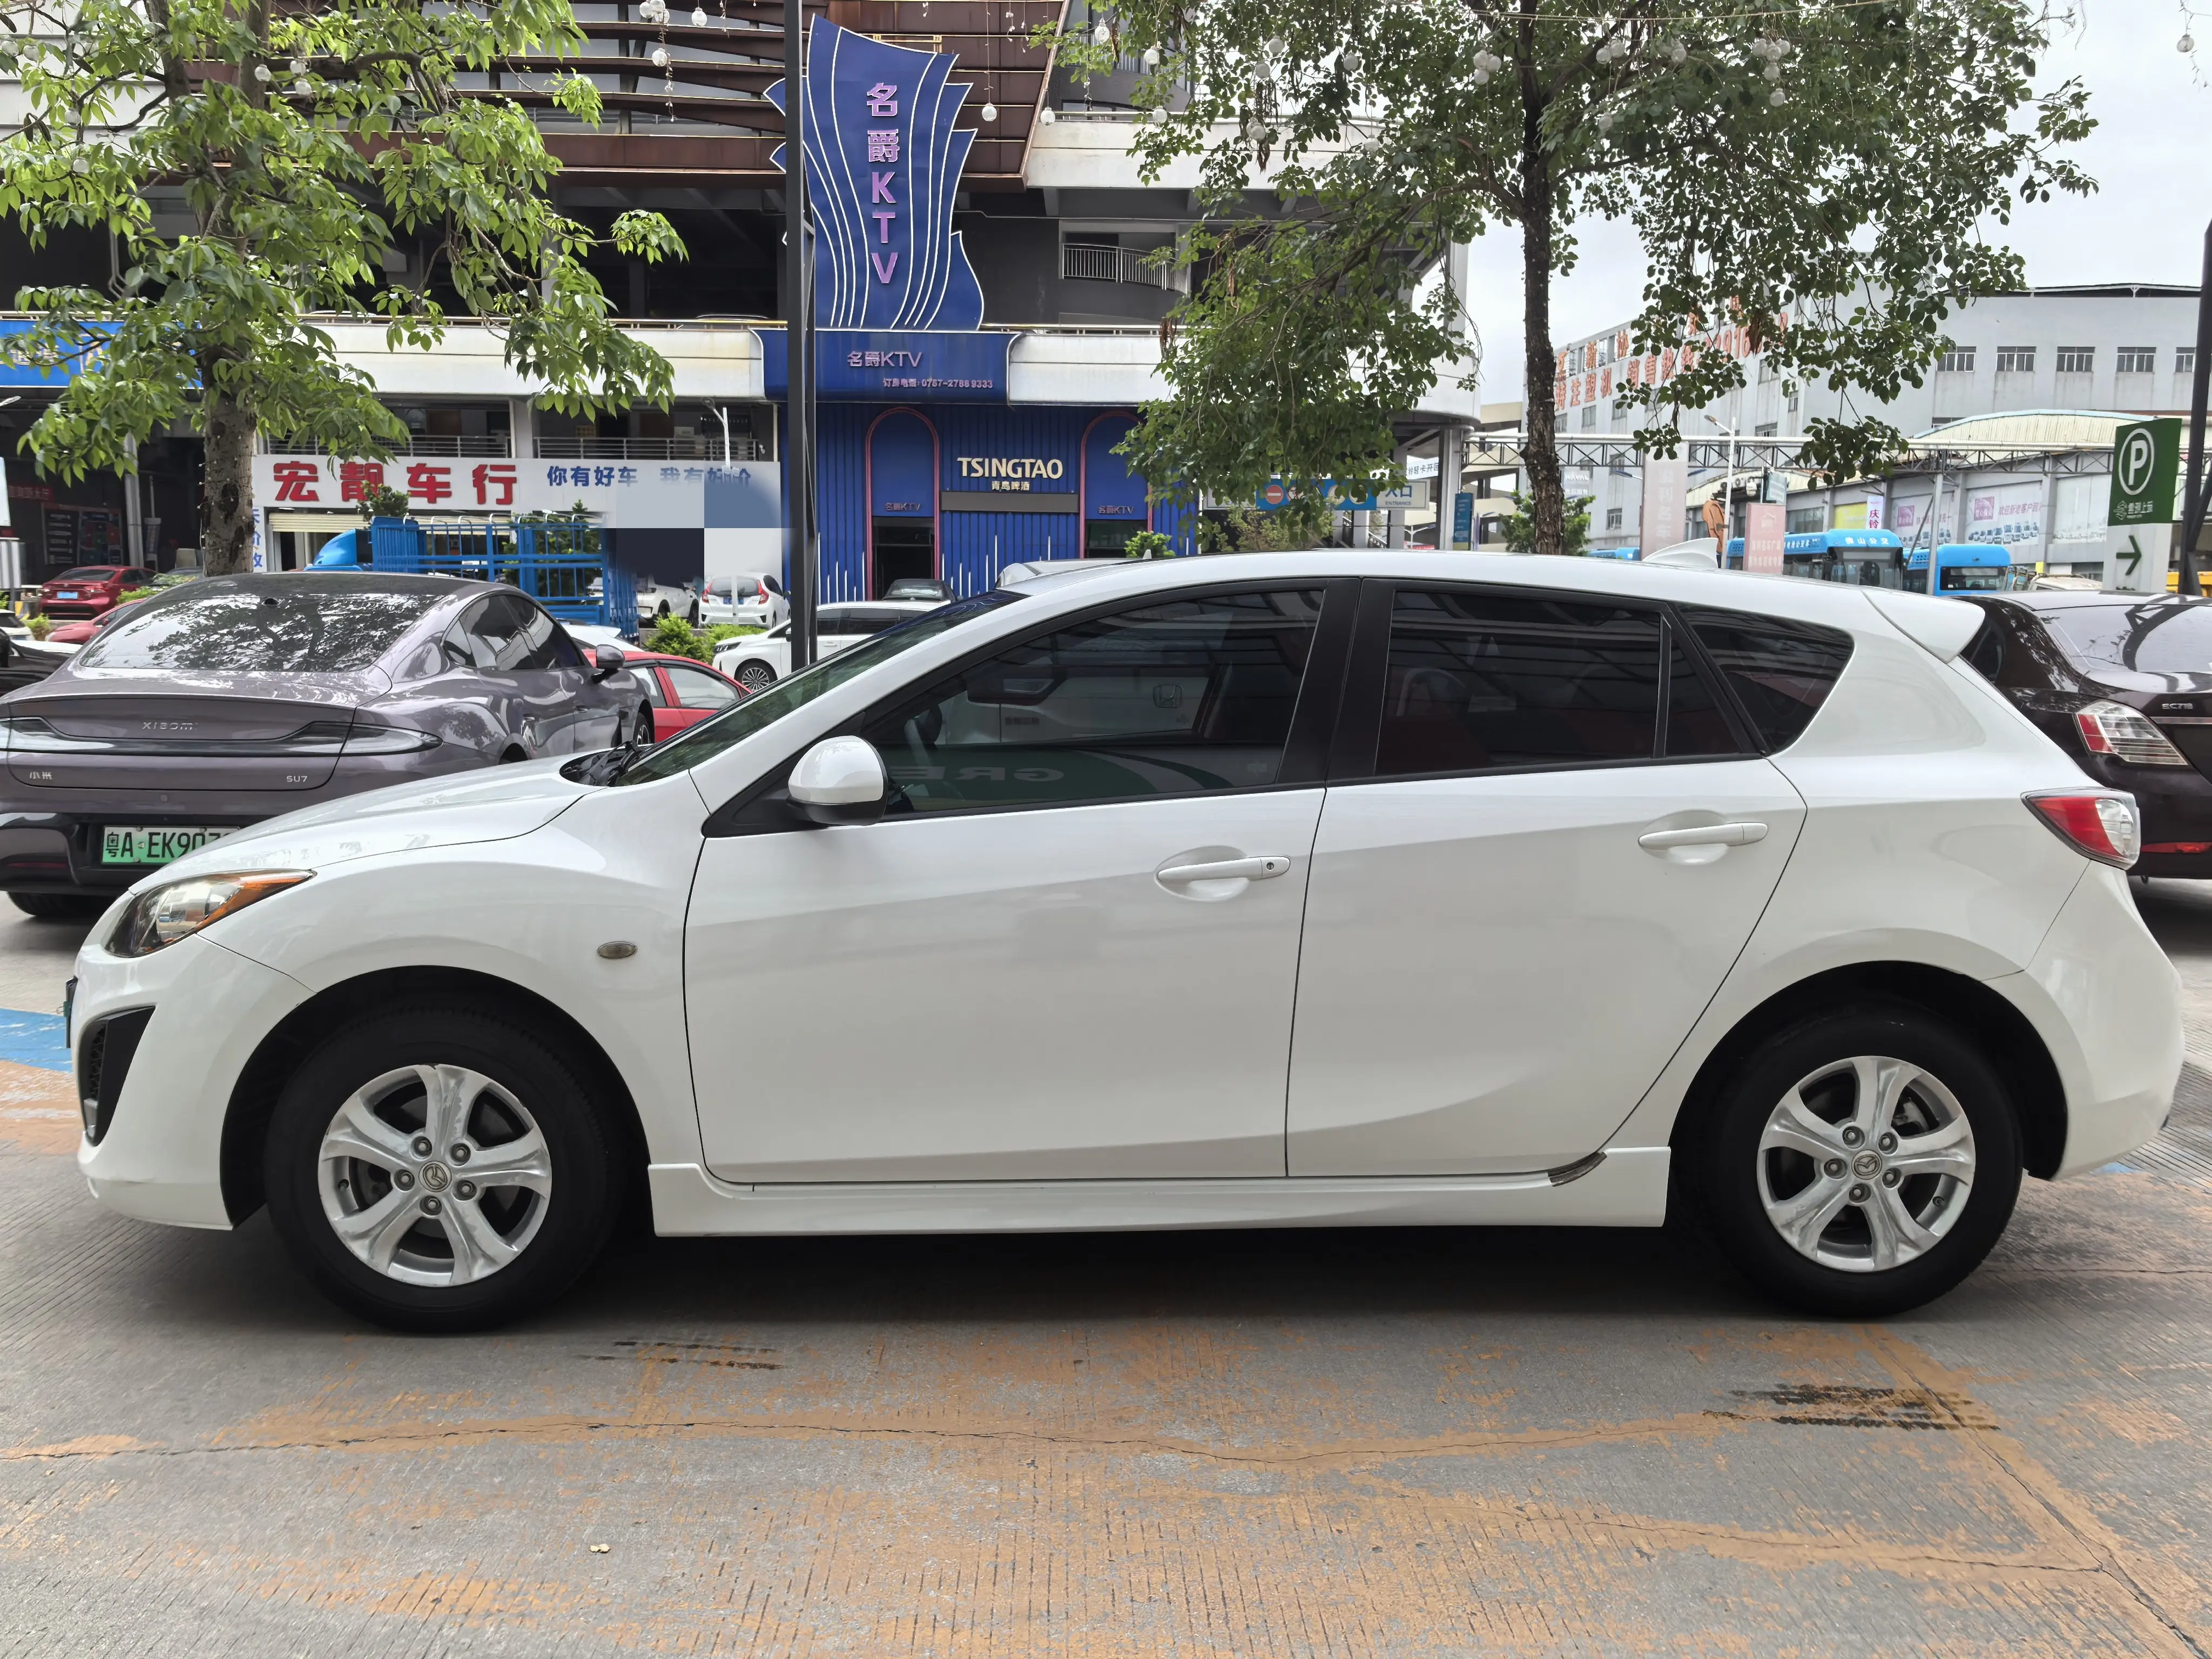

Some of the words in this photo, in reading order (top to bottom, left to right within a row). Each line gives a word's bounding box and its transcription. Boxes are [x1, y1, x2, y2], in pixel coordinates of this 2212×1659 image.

[867, 82, 900, 284] 名爵KTV
[847, 351, 923, 367] 名爵KTV
[957, 457, 1063, 480] TSINGTAO
[2128, 440, 2148, 486] P
[273, 461, 517, 505] 宏靓车行
[547, 466, 638, 487] 你有好车
[992, 481, 1030, 491] 青岛啤酒
[1385, 485, 1412, 497] 入口
[29, 771, 53, 780] 小米
